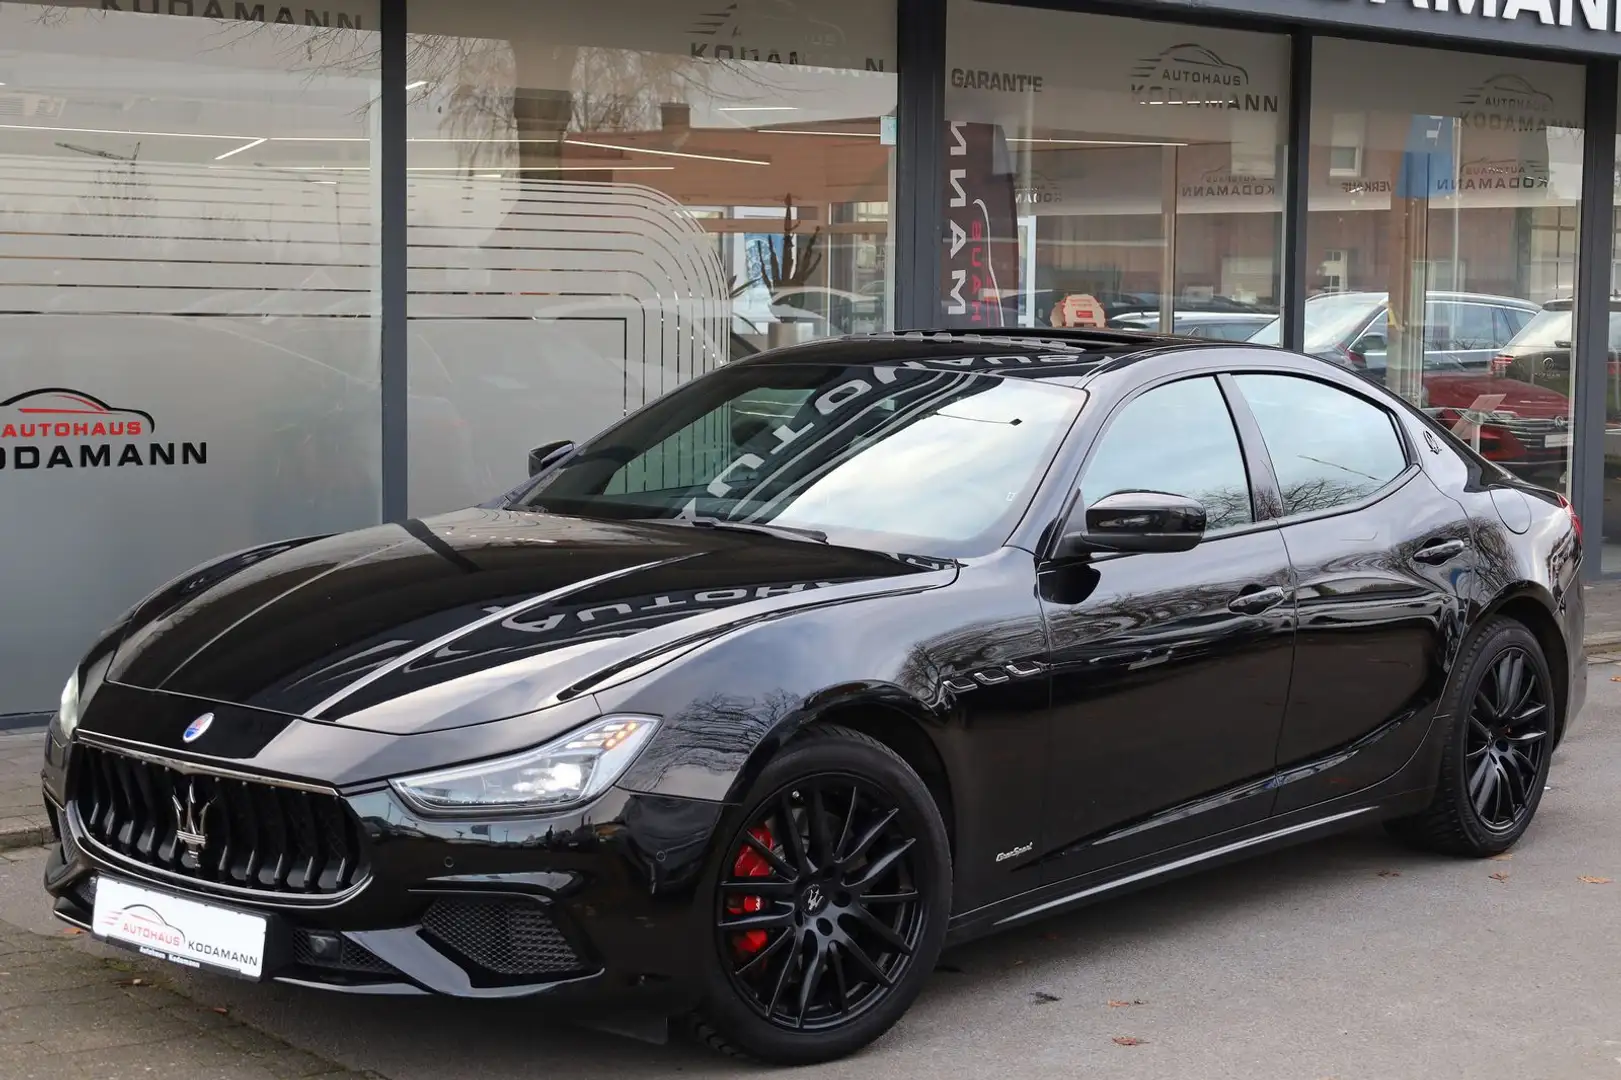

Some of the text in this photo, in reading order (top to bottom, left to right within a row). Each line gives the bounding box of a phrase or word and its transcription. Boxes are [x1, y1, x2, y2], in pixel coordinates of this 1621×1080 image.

[1162, 68, 1241, 86] AUTOHAUS
[1, 421, 142, 438] AUTOHAUS
[123, 923, 180, 946] AUTOHAUS
[187, 939, 258, 967] KODAMANN
